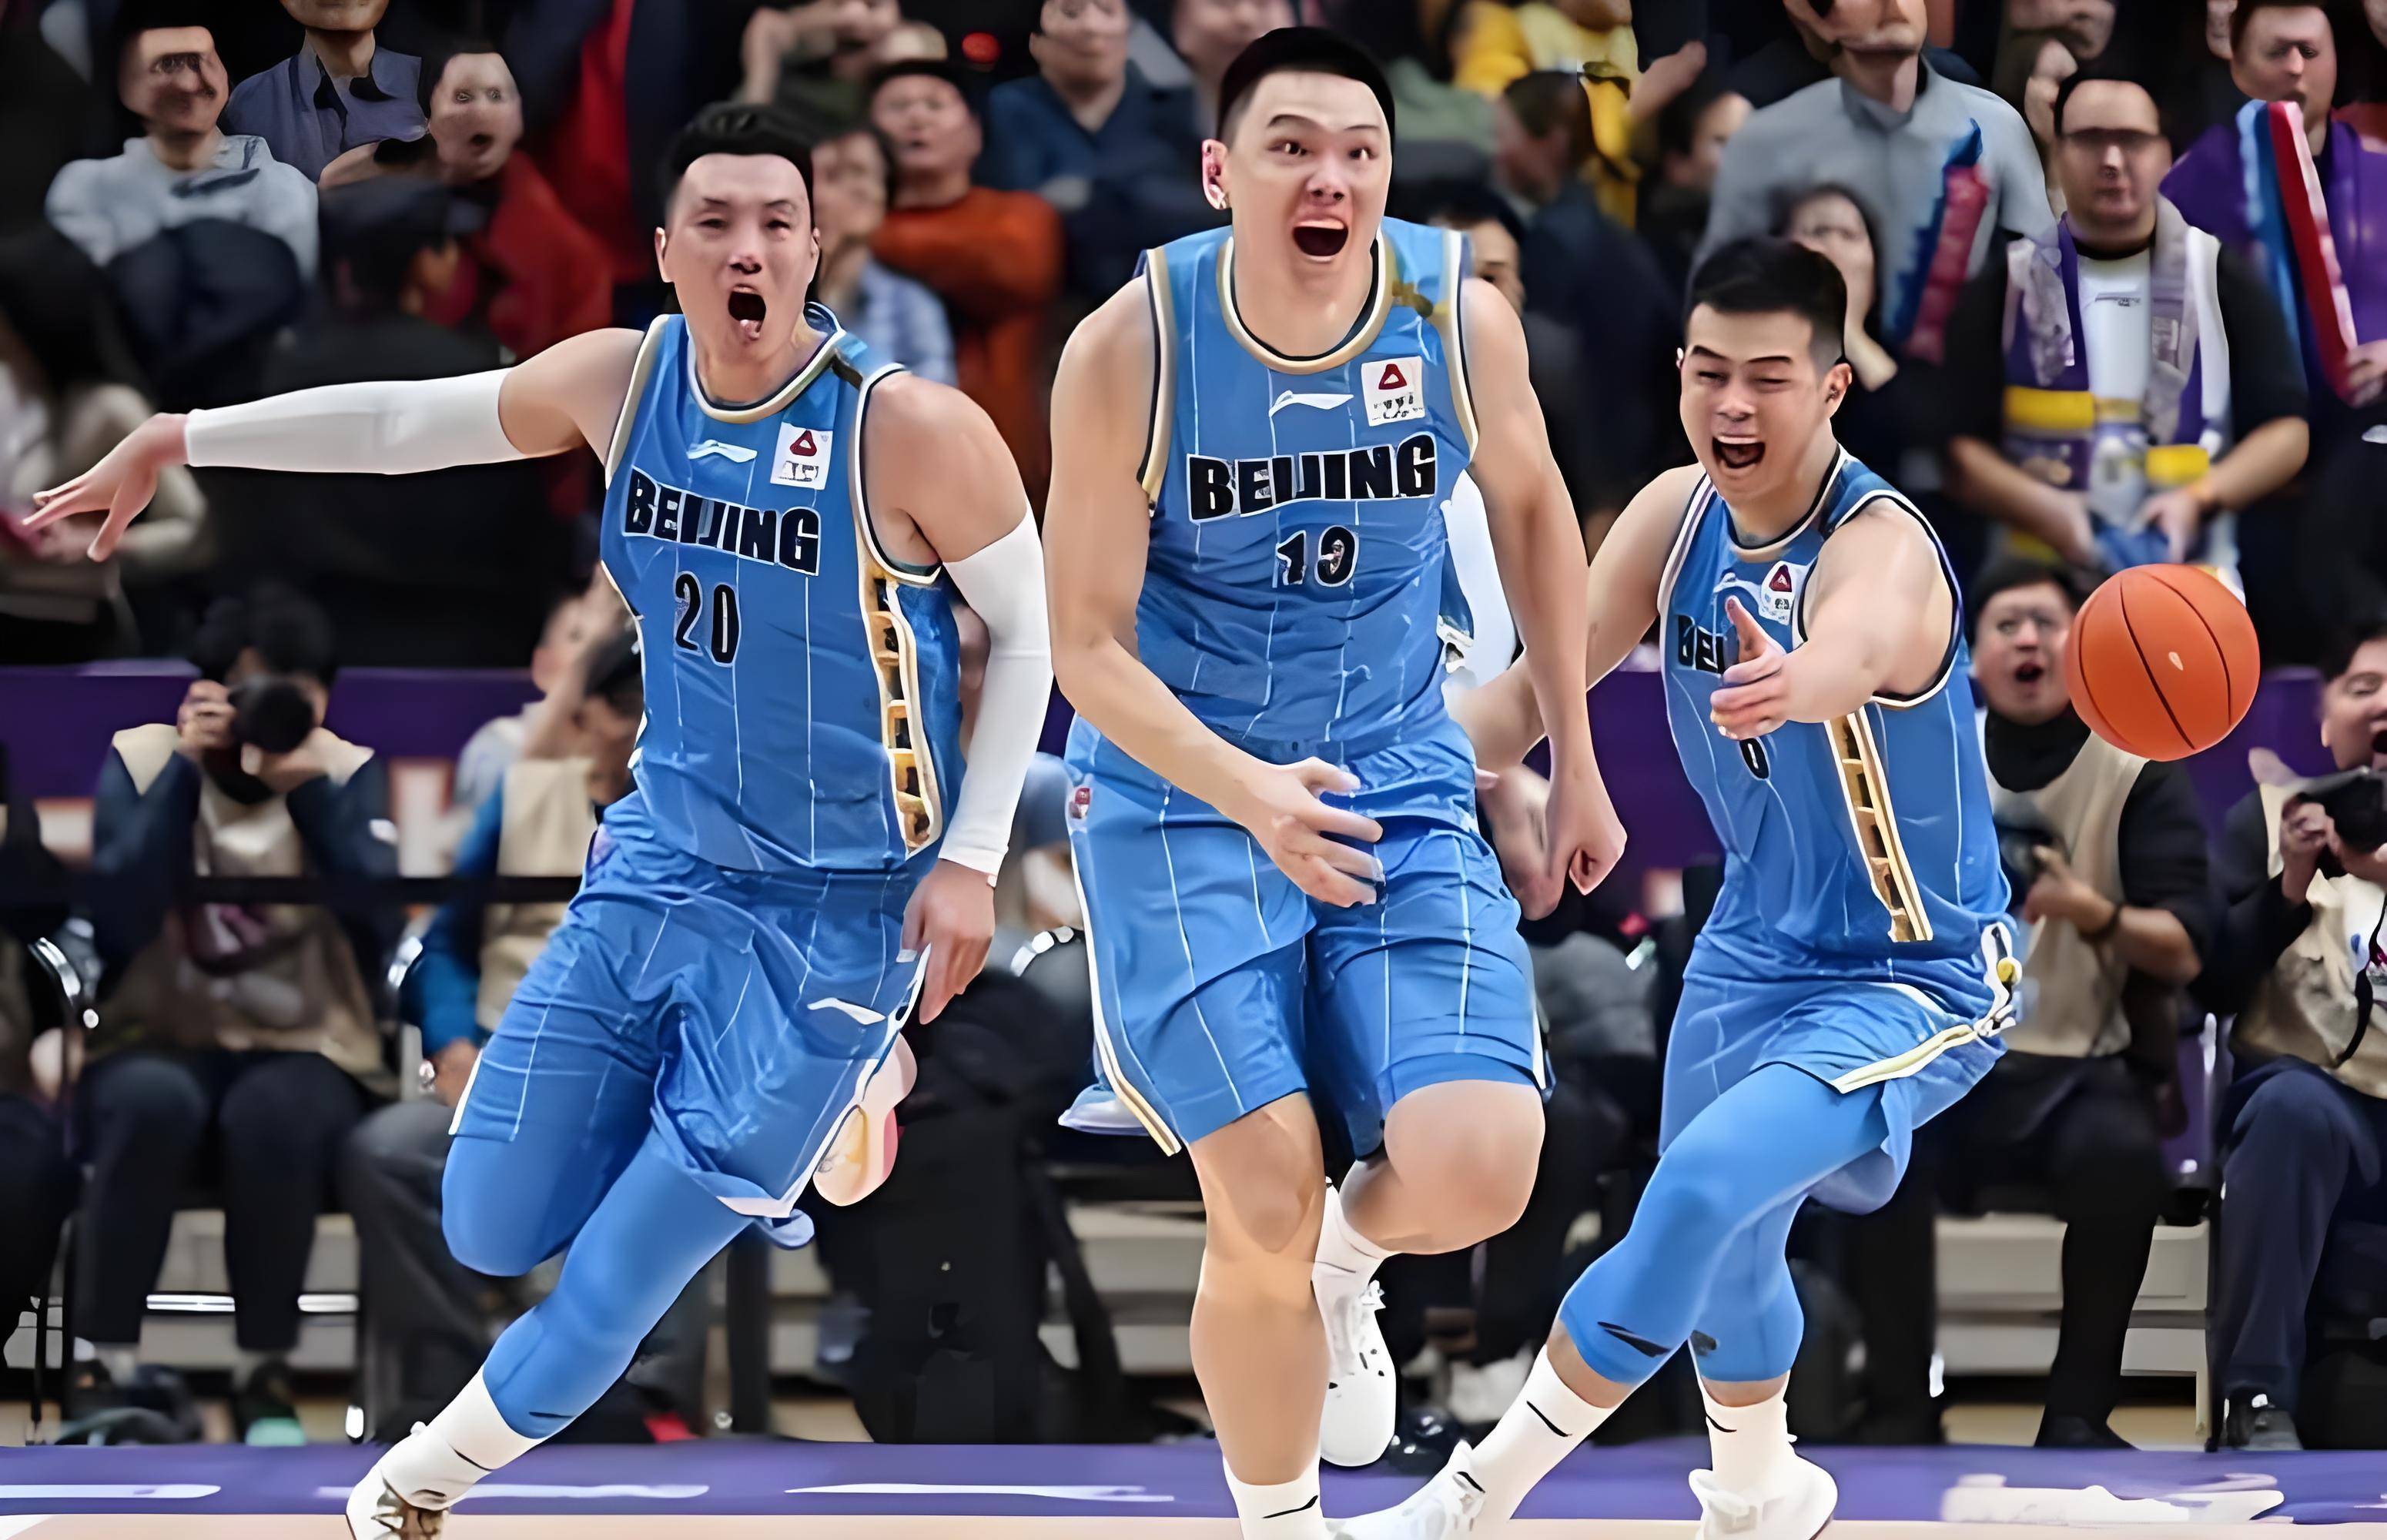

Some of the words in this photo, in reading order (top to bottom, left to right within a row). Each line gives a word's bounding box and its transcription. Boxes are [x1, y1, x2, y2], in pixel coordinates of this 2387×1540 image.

[622, 465, 821, 577] BEIJING
[1187, 431, 1437, 524] BEIJING
[674, 571, 742, 668] 20
